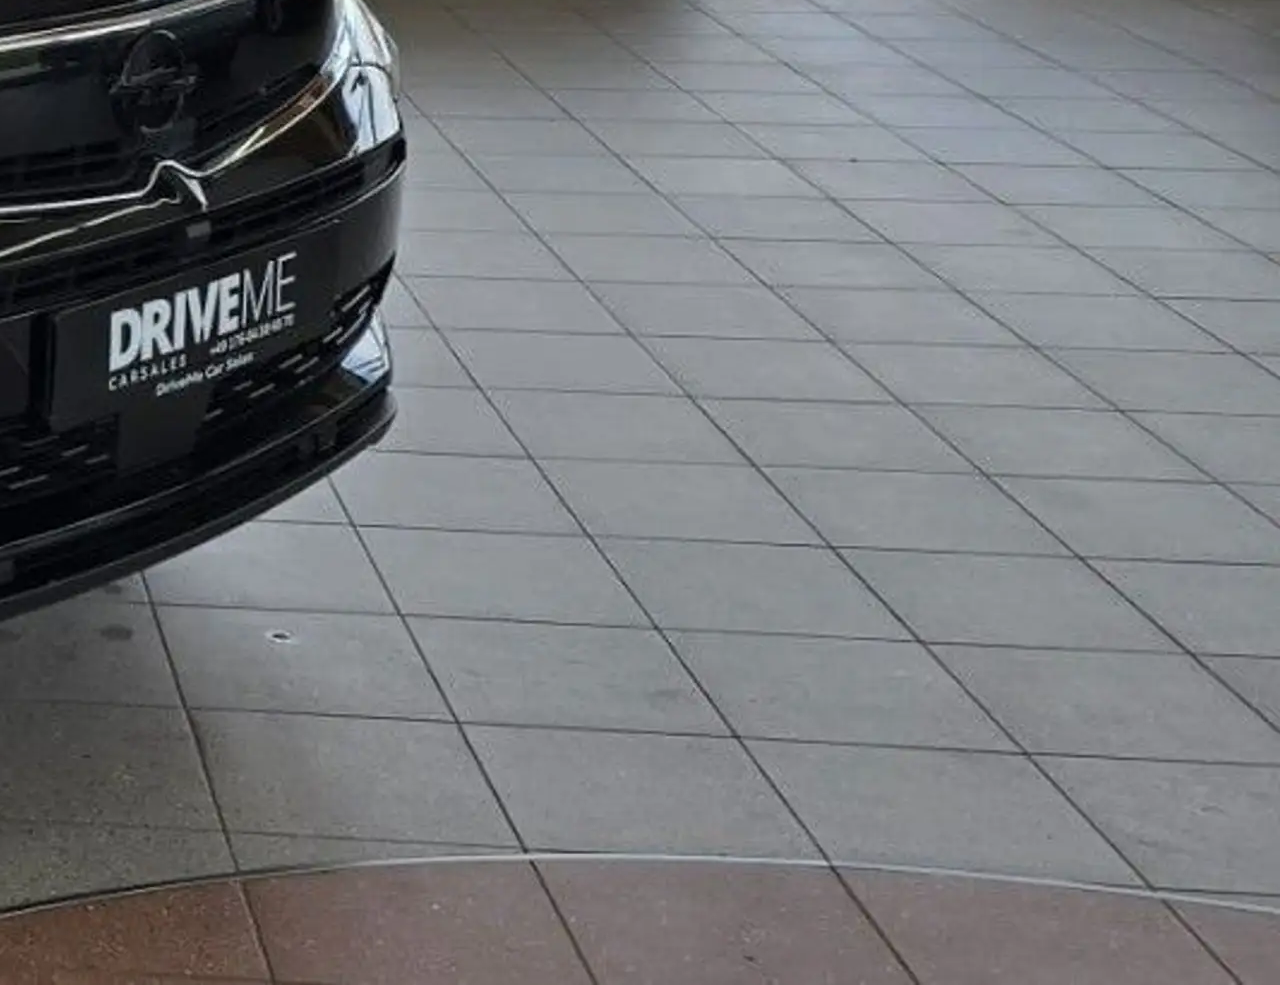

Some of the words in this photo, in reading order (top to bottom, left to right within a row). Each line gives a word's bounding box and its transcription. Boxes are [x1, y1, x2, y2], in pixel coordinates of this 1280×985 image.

[109, 251, 297, 373] DRIVEME
[108, 354, 187, 391] CARSALES
[204, 363, 224, 378] Car
